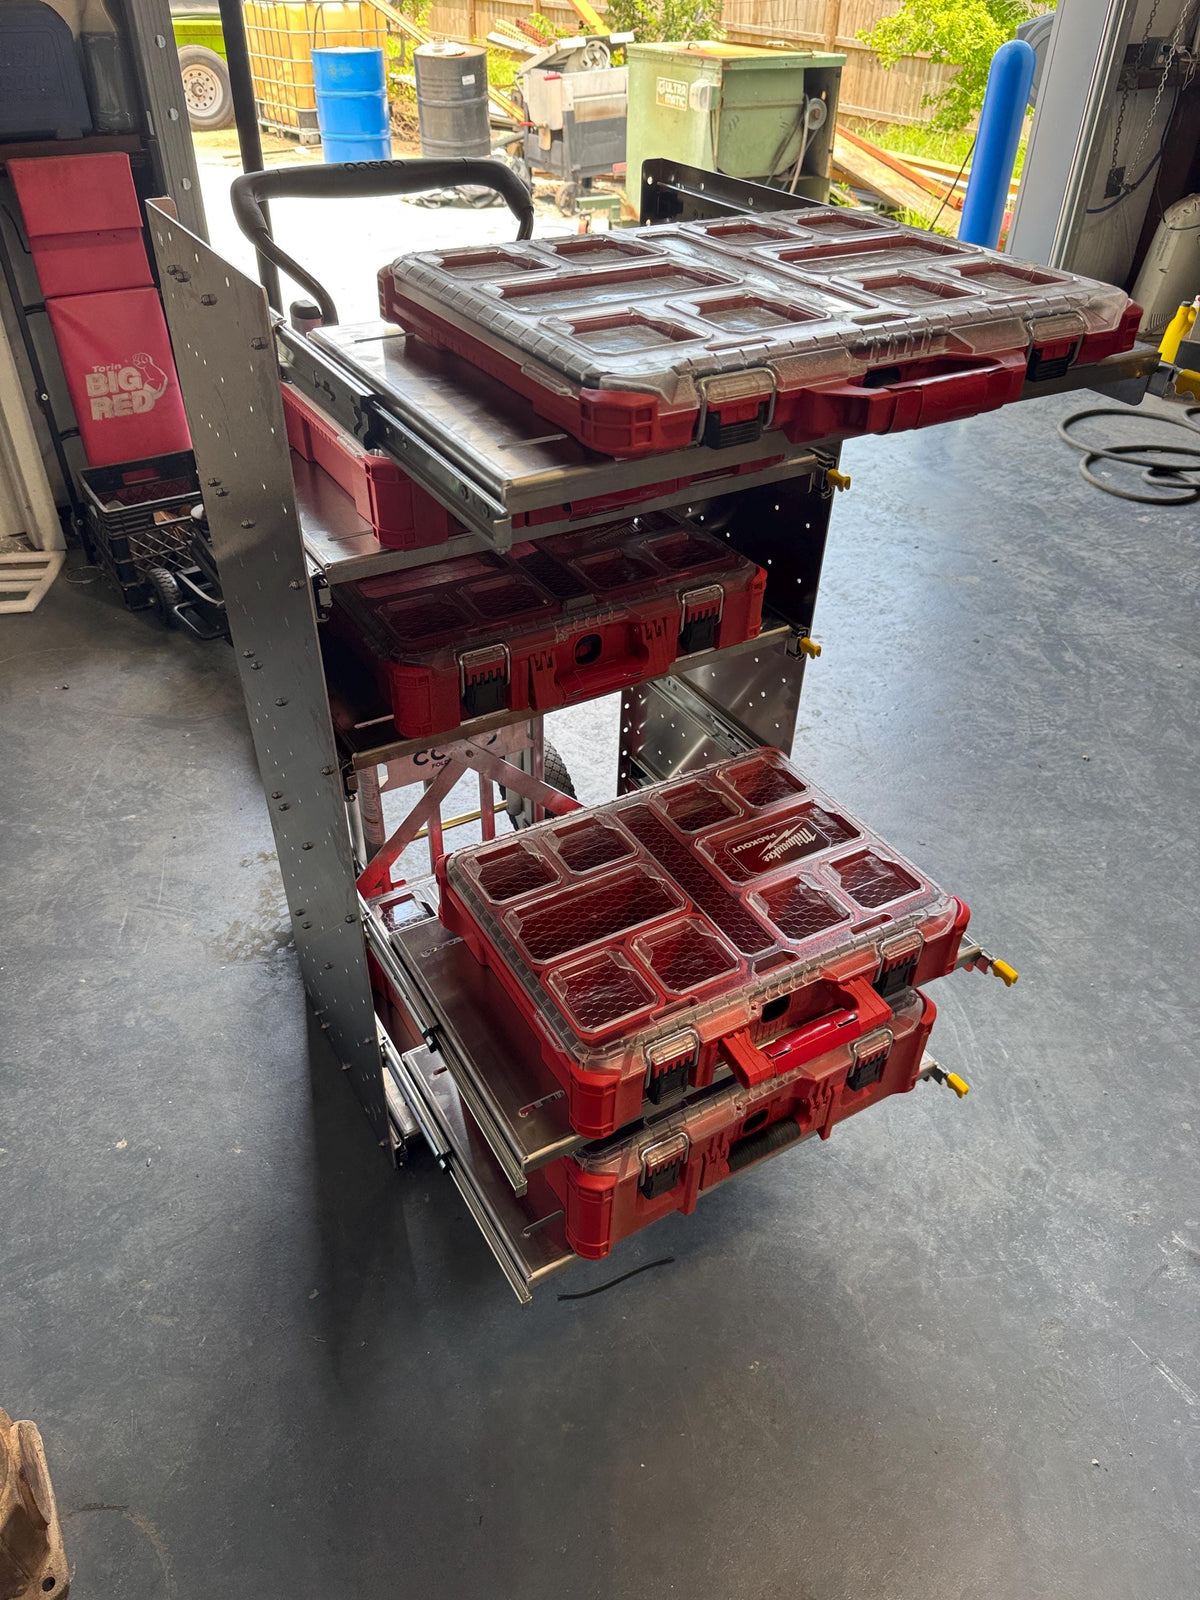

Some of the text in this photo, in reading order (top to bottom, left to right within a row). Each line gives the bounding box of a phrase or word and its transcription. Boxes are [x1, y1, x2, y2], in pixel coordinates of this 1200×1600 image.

[665, 81, 686, 97] ULTRA
[92, 363, 122, 373] Torin
[85, 366, 142, 397] BIG
[90, 390, 155, 421] RED
[731, 832, 778, 854] PACKOUT
[762, 827, 817, 862] Milwaukee
